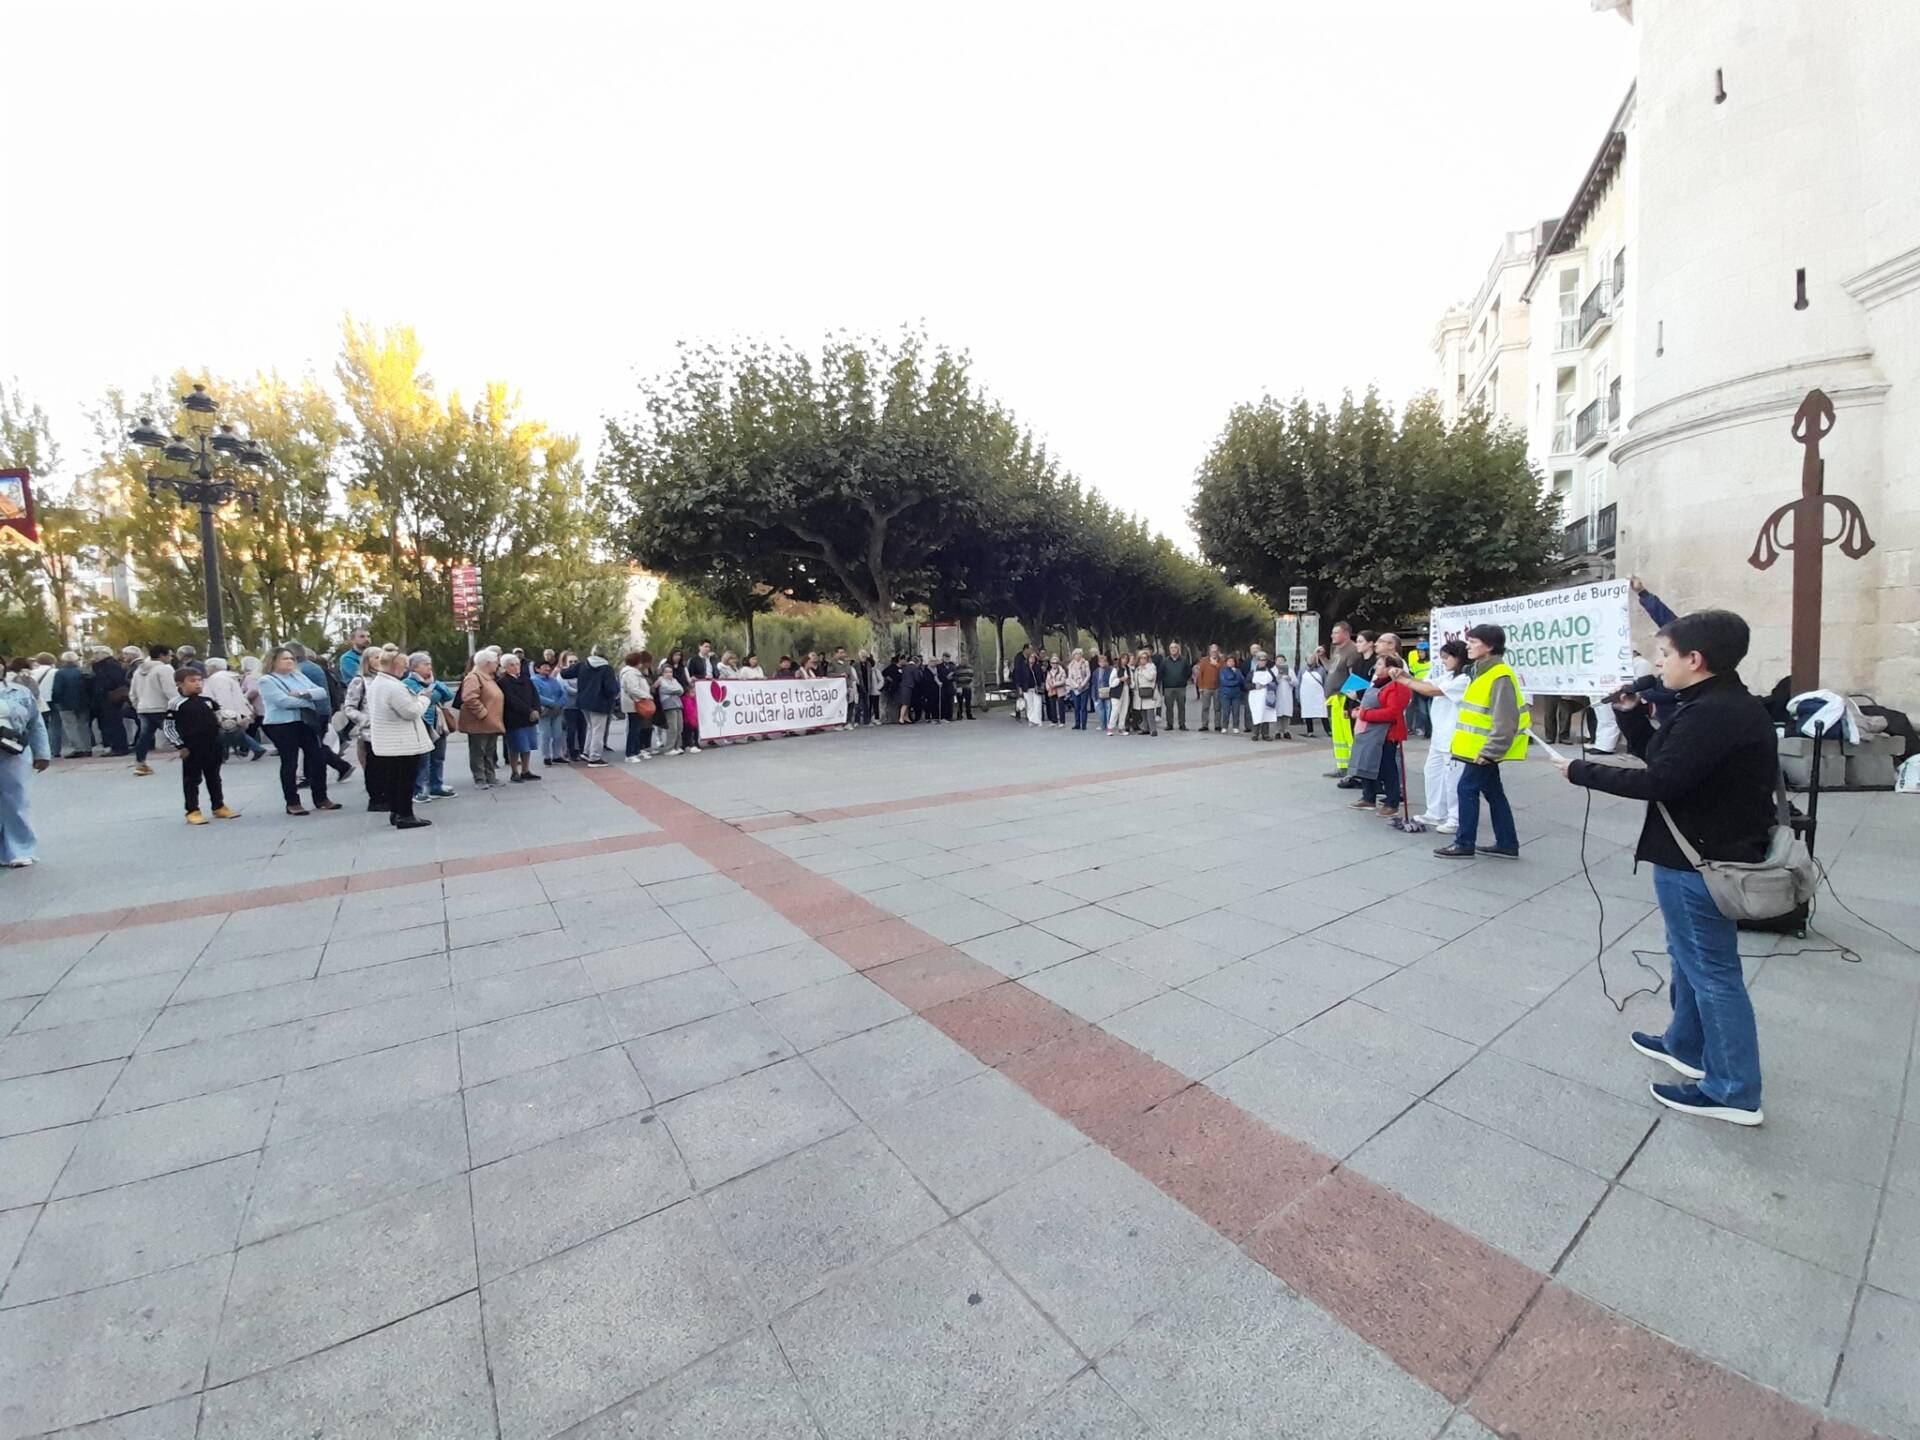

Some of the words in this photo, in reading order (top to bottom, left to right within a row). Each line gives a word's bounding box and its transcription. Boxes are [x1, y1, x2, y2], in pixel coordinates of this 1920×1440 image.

[1494, 601, 1524, 614] Trabajo
[1527, 595, 1570, 608] Decente
[1573, 590, 1588, 601] de
[1502, 615, 1590, 643] RABAJO
[1506, 642, 1594, 667] DECENTE
[734, 689, 777, 706] cuidar
[781, 688, 793, 704] el
[795, 687, 838, 704] trabajo
[735, 706, 780, 725] cuidar
[783, 705, 795, 720] la
[798, 703, 824, 719] vida
